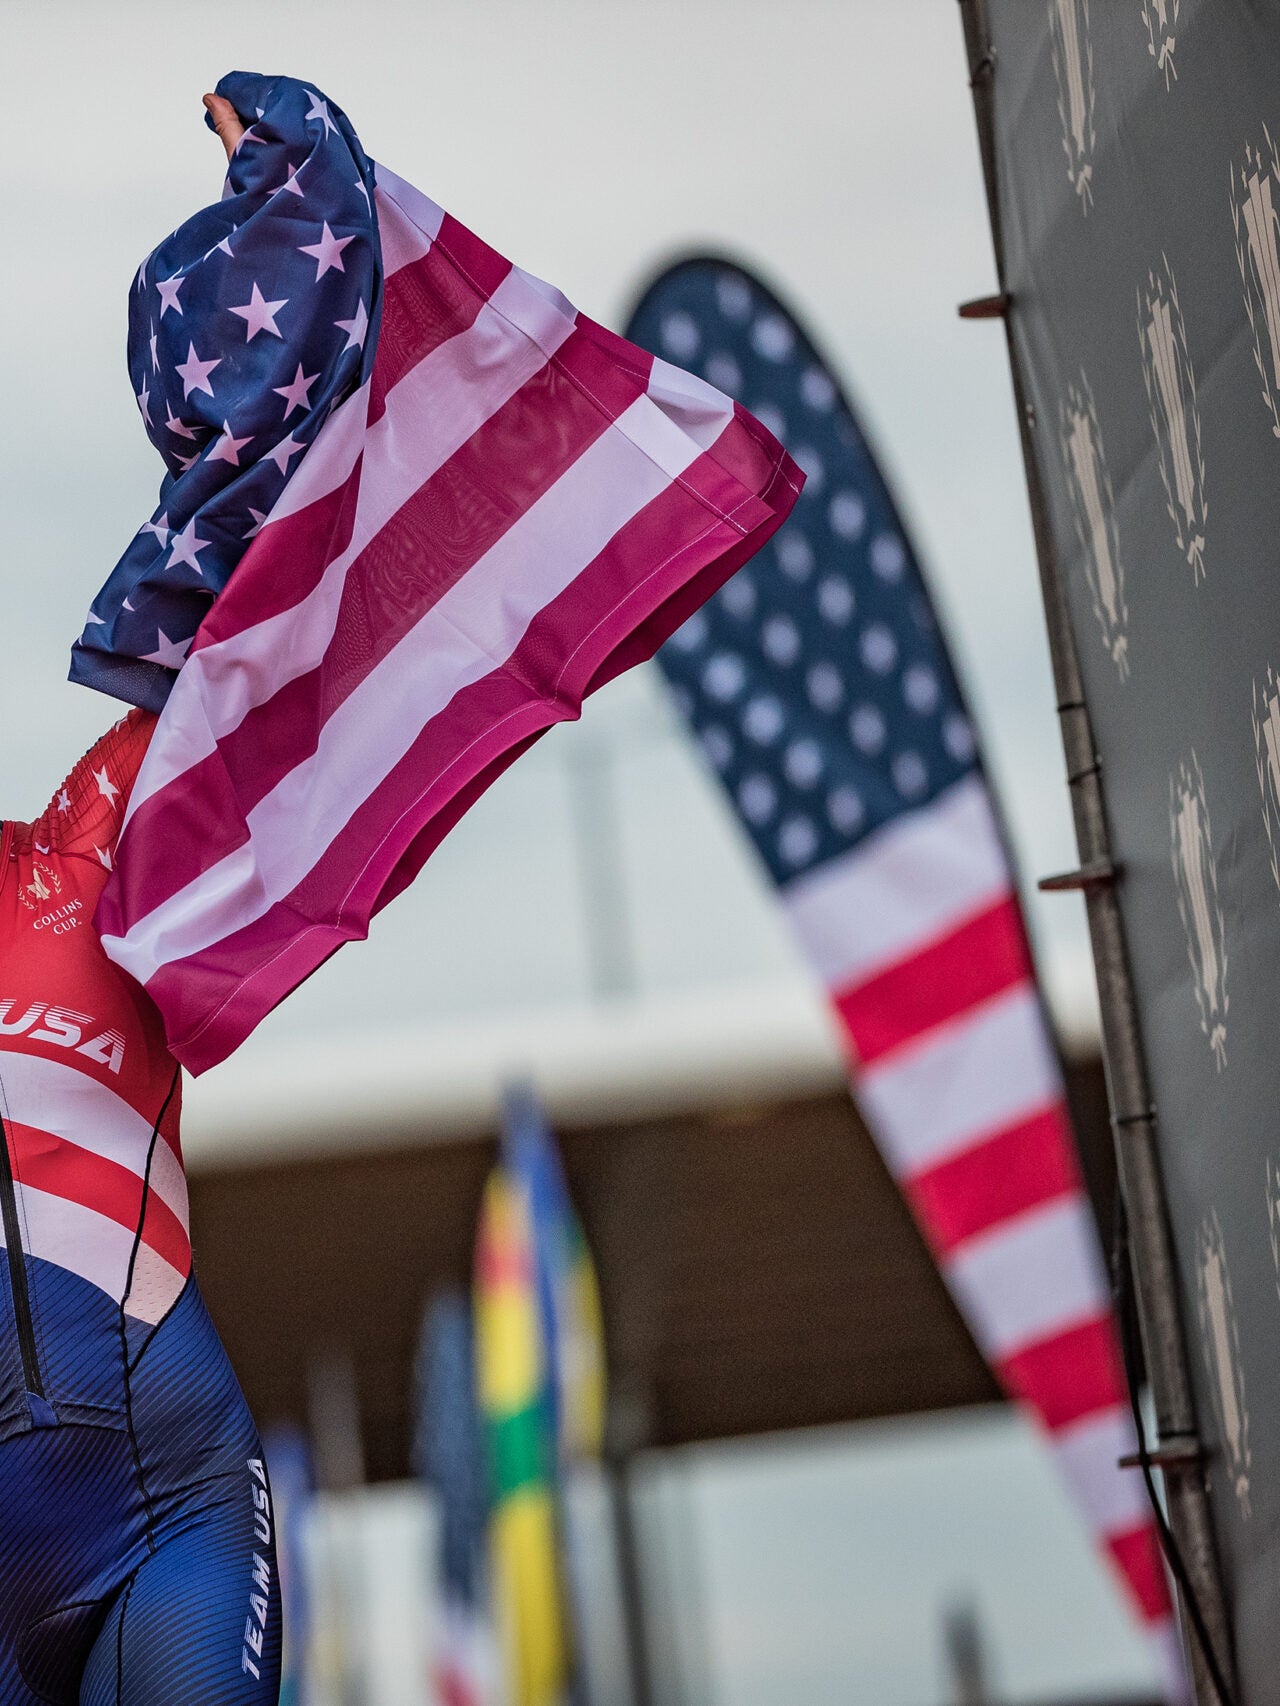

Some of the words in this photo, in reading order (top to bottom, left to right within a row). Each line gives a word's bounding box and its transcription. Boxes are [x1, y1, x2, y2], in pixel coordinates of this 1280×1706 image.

[33, 898, 83, 930] COLLINS
[247, 1458, 270, 1545] USA
[241, 1551, 270, 1680] TEAM
